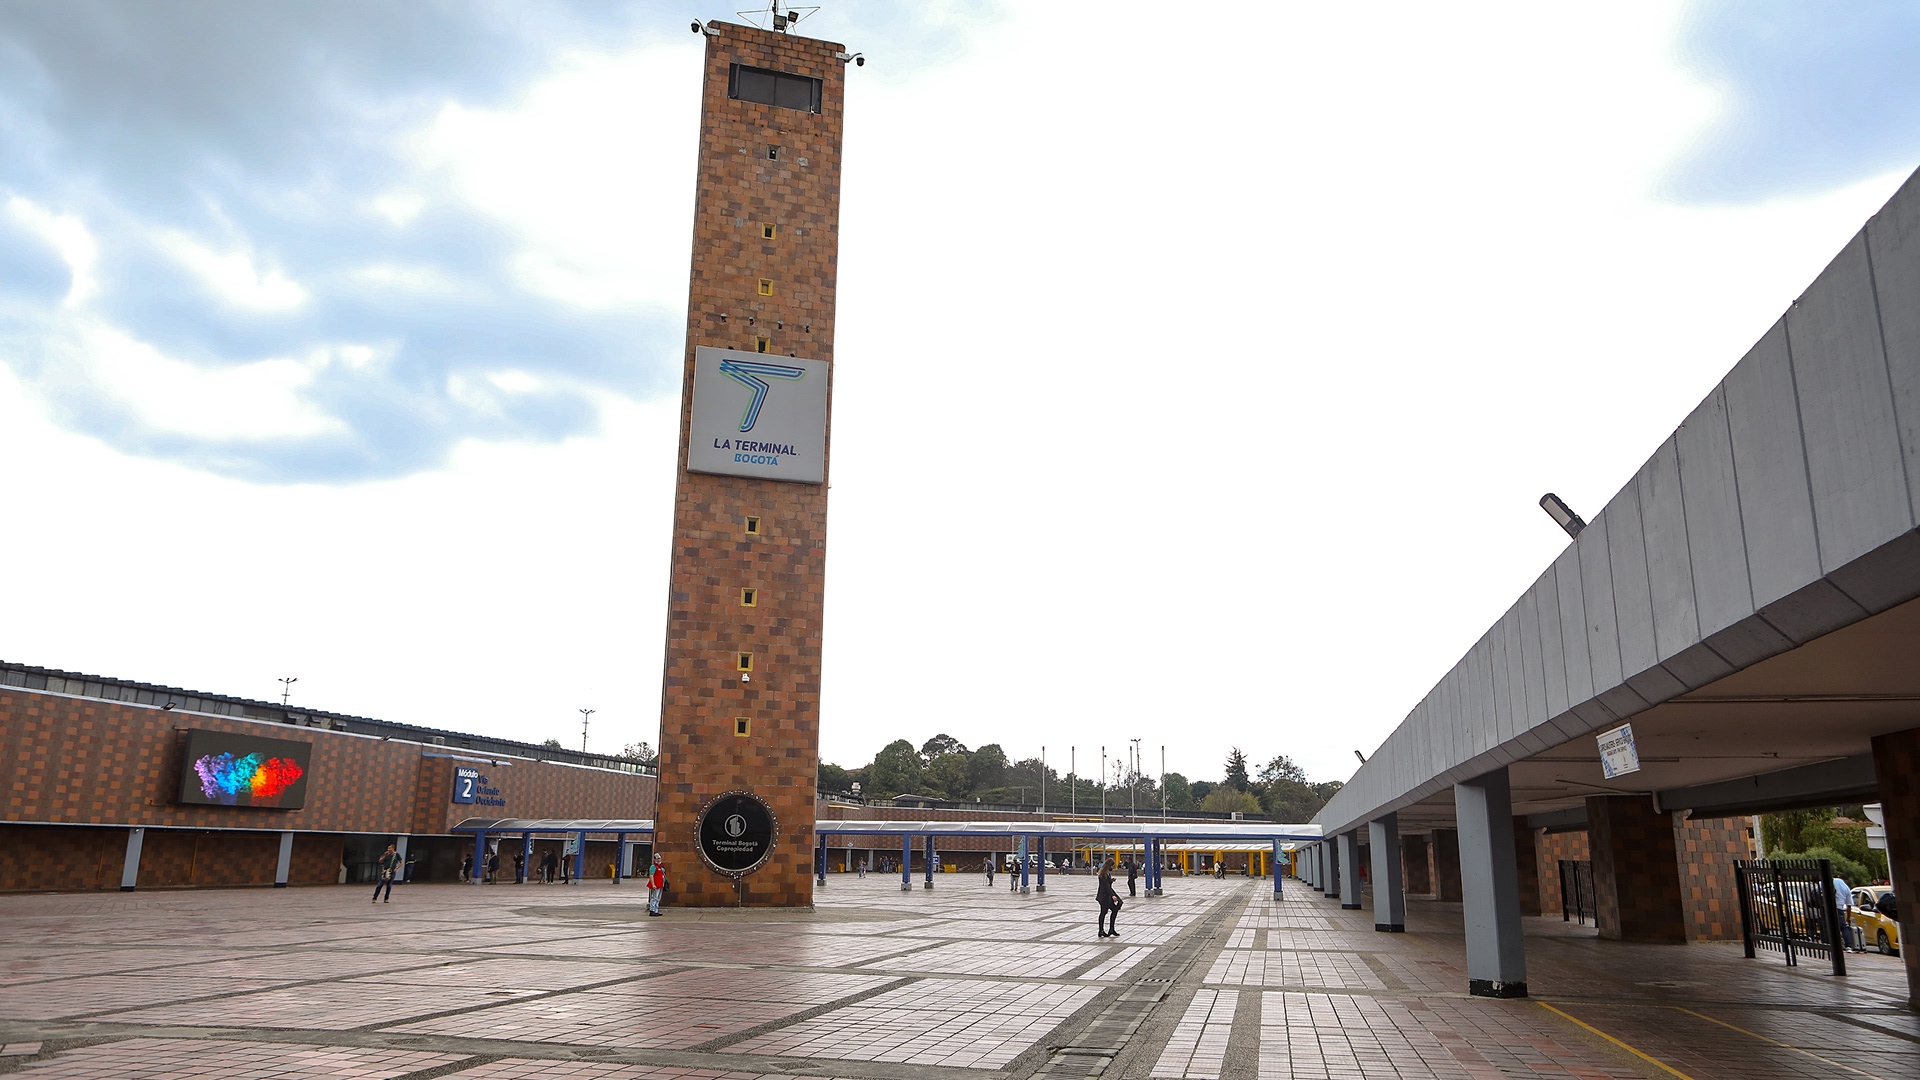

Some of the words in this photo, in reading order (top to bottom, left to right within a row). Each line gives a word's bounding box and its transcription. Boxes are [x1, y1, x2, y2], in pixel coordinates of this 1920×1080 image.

[713, 438, 731, 450] LA
[734, 440, 797, 456] TERMINAL
[734, 453, 779, 466] BOGOTÁ
[458, 769, 478, 778] Módulo
[462, 779, 472, 798] 2
[475, 796, 506, 807] Occidente
